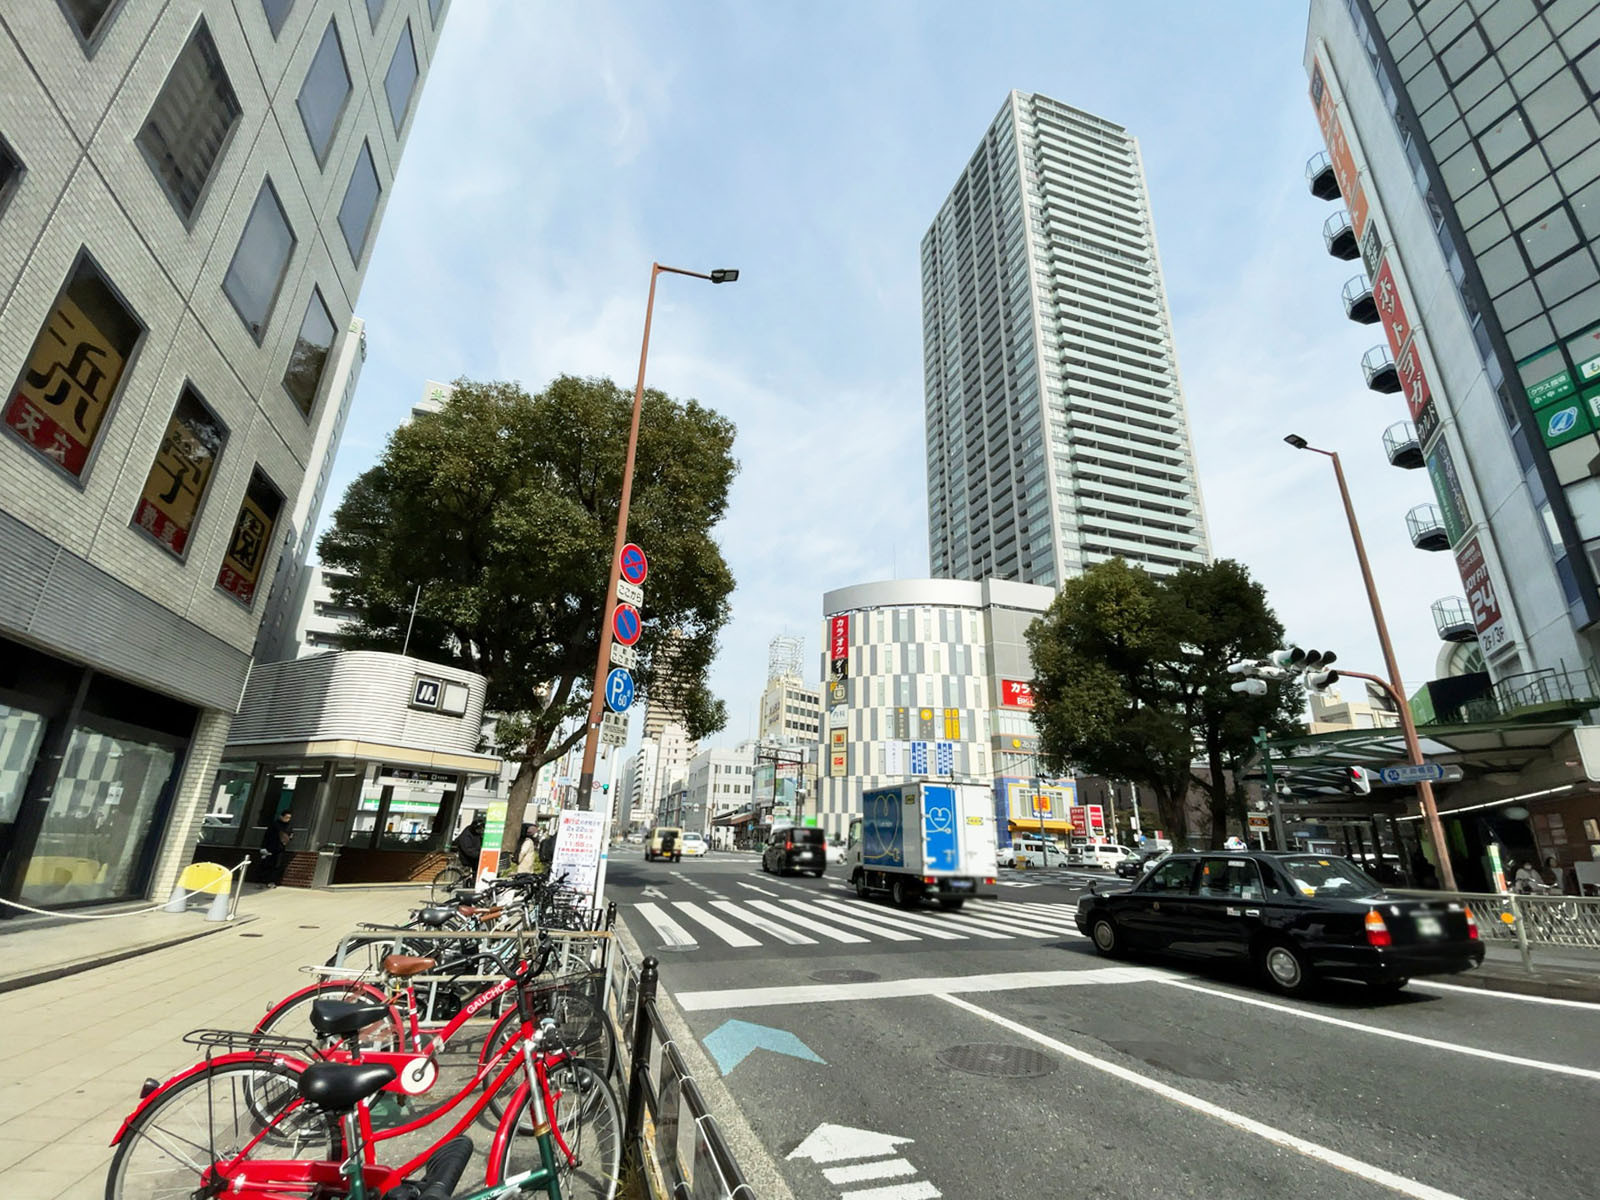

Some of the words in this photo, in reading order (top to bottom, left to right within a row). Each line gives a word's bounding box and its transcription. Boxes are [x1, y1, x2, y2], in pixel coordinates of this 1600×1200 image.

[618, 584, 643, 603] ここから
[1470, 580, 1497, 627] 24
[835, 619, 845, 655] カラオケ
[466, 982, 506, 1015] GAUCHO
